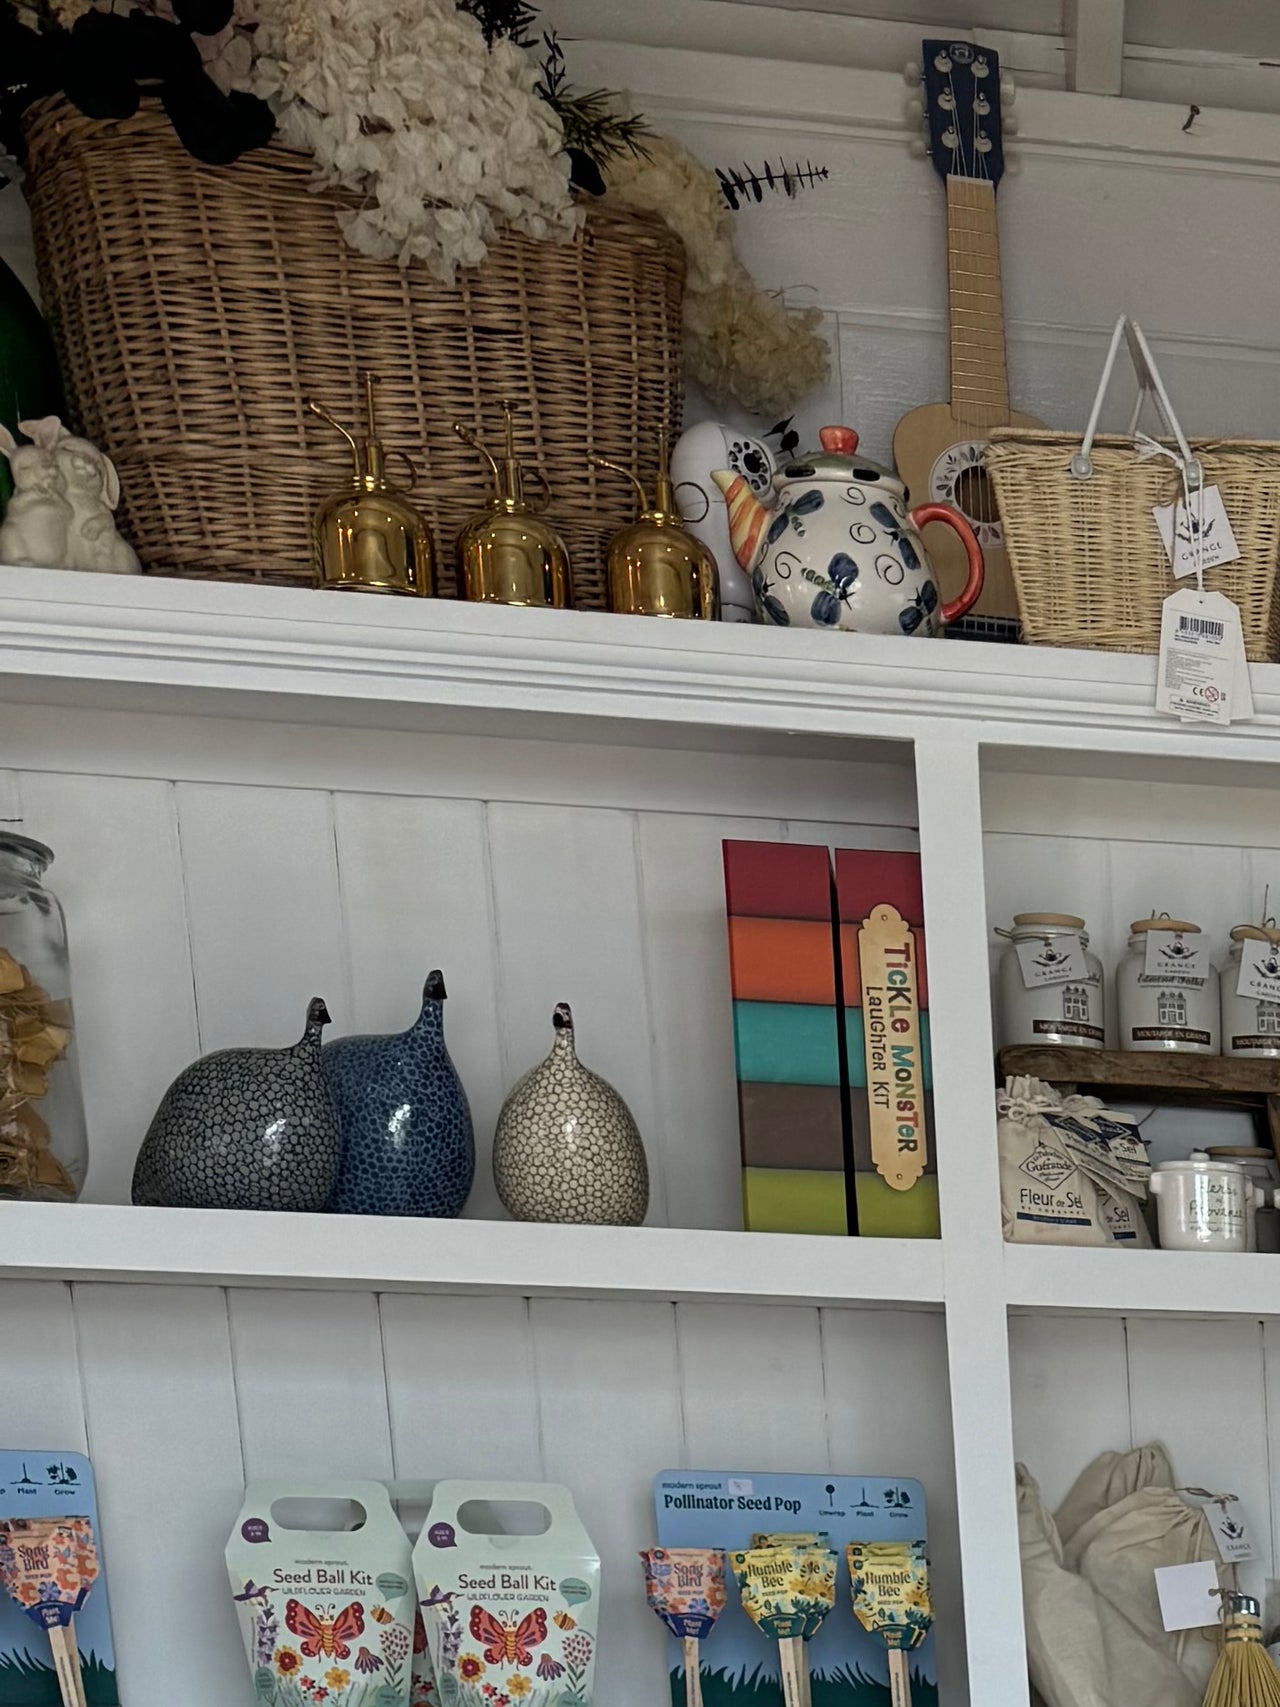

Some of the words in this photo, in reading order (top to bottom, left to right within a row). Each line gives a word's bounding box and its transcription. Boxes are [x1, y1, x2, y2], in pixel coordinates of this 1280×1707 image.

[1156, 961, 1197, 970] GRANGE
[1020, 1188, 1055, 1207] Fleur
[1066, 1192, 1084, 1209] Sel
[661, 1482, 694, 1490] modern
[695, 1482, 722, 1492] sprout
[663, 1494, 735, 1511] Pollinator
[737, 1495, 773, 1511] Seed
[774, 1497, 802, 1515] Pop
[23, 1557, 49, 1571] Bird
[673, 1561, 704, 1577] Song
[747, 1560, 793, 1579] Humble
[272, 1568, 312, 1584] Seed
[317, 1569, 345, 1584] Ball
[350, 1571, 373, 1586] Kit
[458, 1574, 496, 1589] Seed
[501, 1574, 529, 1590] Ball
[534, 1576, 557, 1591] Kit
[676, 1575, 702, 1588] Bird
[760, 1576, 785, 1589] Bee
[864, 1570, 911, 1585] Humble
[281, 1587, 332, 1595] WILDFLOWER
[333, 1588, 367, 1597] GARDEN
[466, 1593, 516, 1602] WILDFLOWER
[516, 1594, 550, 1602] GARDEN
[878, 1584, 901, 1597] Bee
